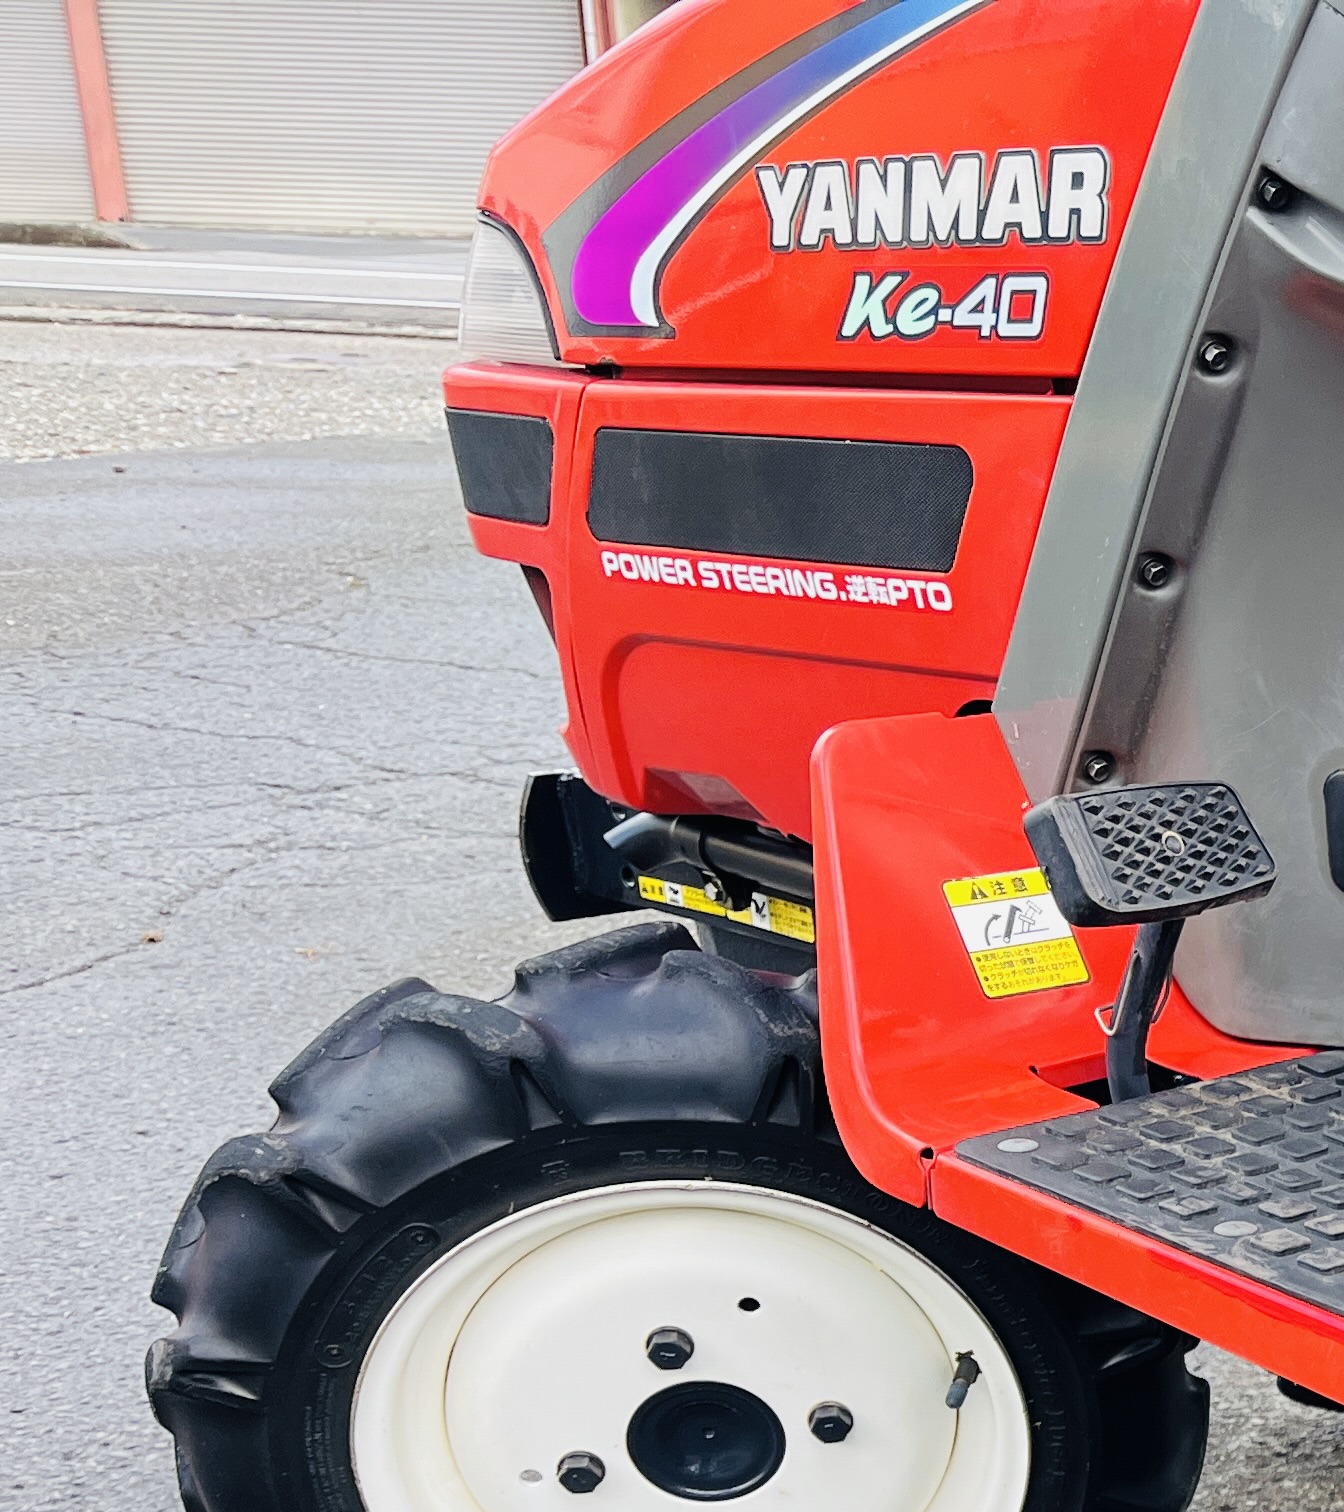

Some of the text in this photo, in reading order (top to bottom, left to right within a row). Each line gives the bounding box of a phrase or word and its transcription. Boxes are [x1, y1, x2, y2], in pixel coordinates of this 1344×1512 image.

[756, 144, 1109, 253] YANMAR
[838, 271, 1050, 343] Ke-40
[600, 550, 697, 588] POWER
